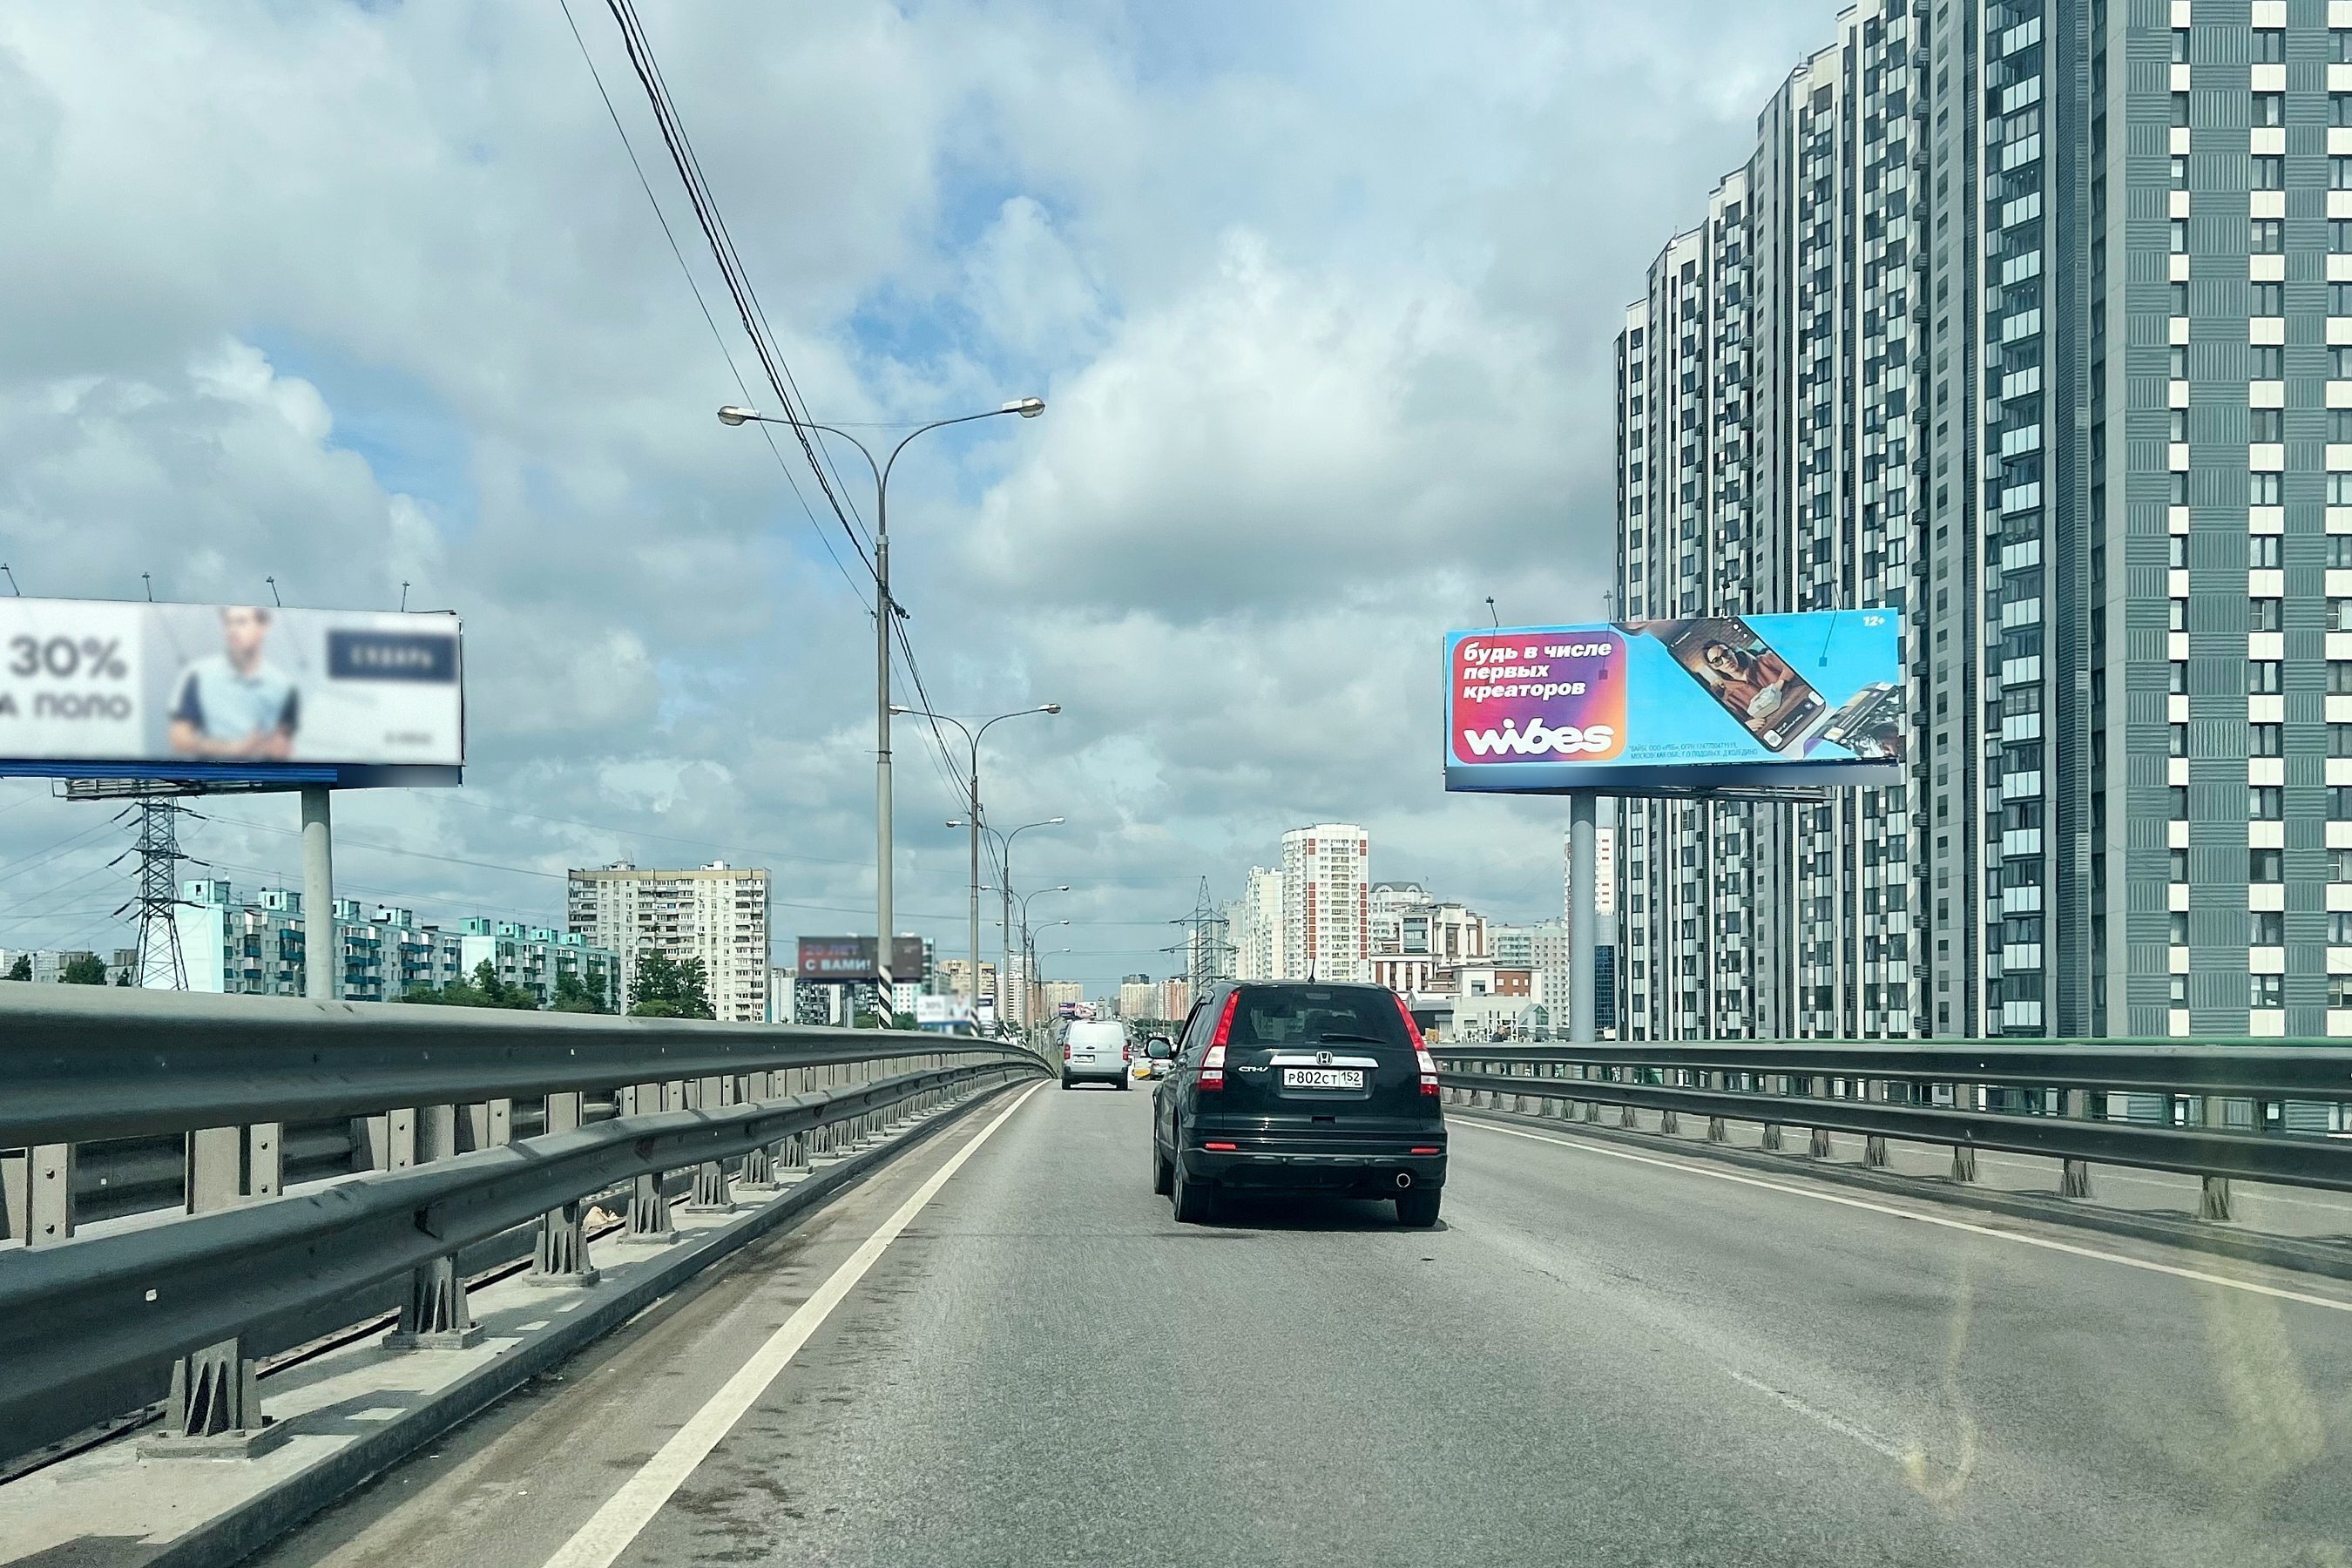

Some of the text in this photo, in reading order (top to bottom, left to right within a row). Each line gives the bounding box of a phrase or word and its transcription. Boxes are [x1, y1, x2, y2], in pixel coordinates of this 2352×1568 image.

[1862, 615, 1886, 627] 12+
[9, 634, 128, 680] 30%
[1463, 641, 1612, 666] будь в числе
[1463, 664, 1551, 684] первых
[1463, 682, 1586, 703] креаторов
[1463, 717, 1615, 756] wibes
[821, 959, 871, 971] ВАМИ!
